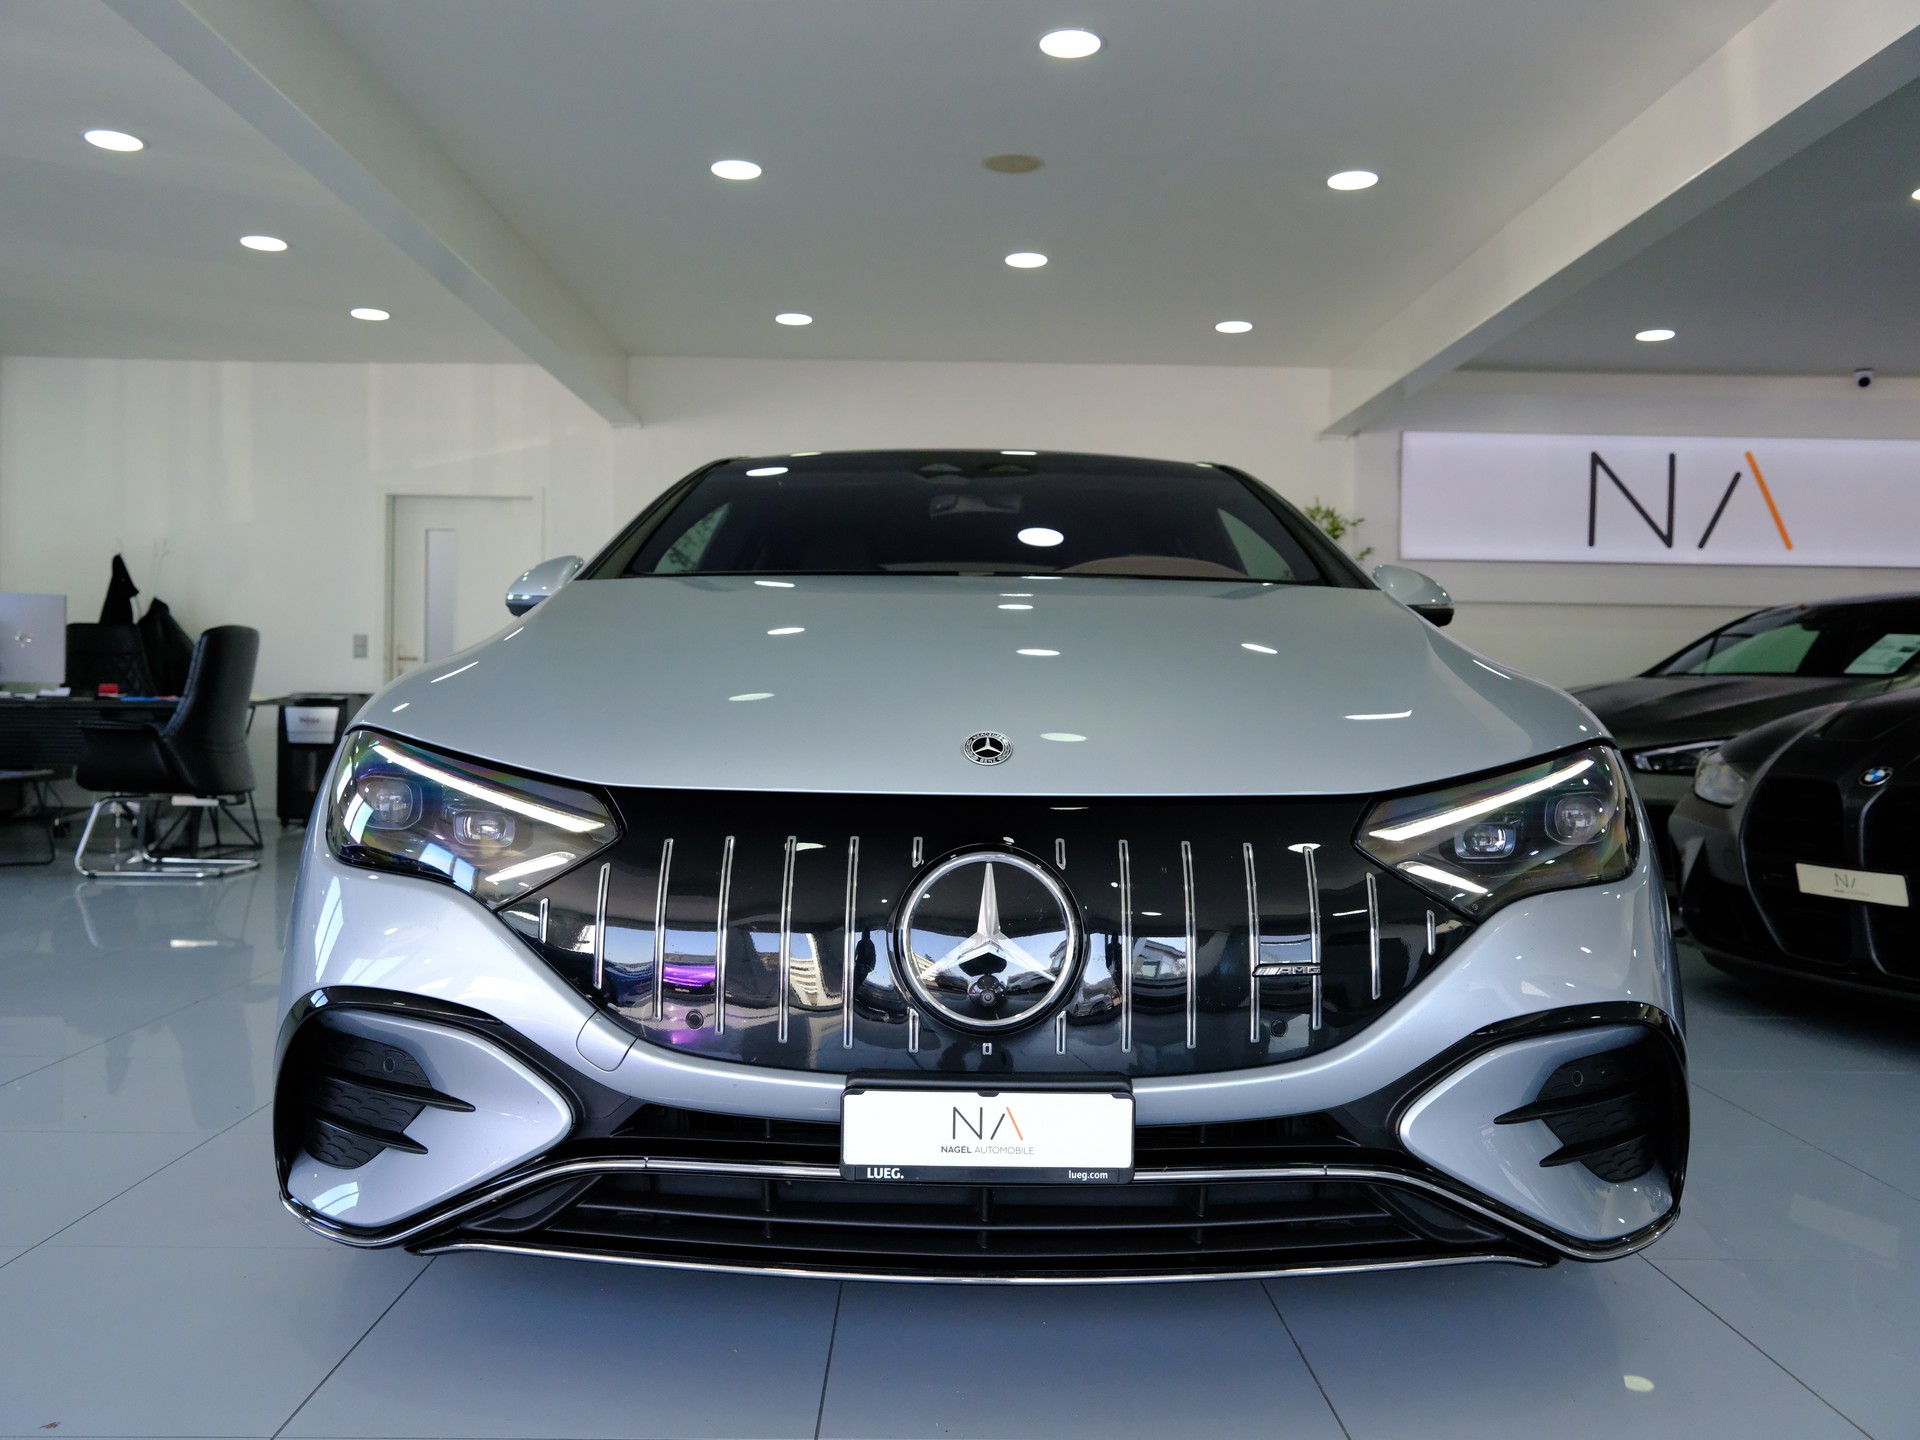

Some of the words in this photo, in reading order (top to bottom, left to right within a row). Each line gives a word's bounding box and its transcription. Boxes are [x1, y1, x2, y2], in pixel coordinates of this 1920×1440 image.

[1275, 966, 1321, 975] AMG
[940, 1145, 972, 1154] NAGEL
[974, 1146, 1035, 1155] AUTOMOBILE
[866, 1167, 904, 1179] LUEG.
[1068, 1169, 1108, 1181] lueg.com
